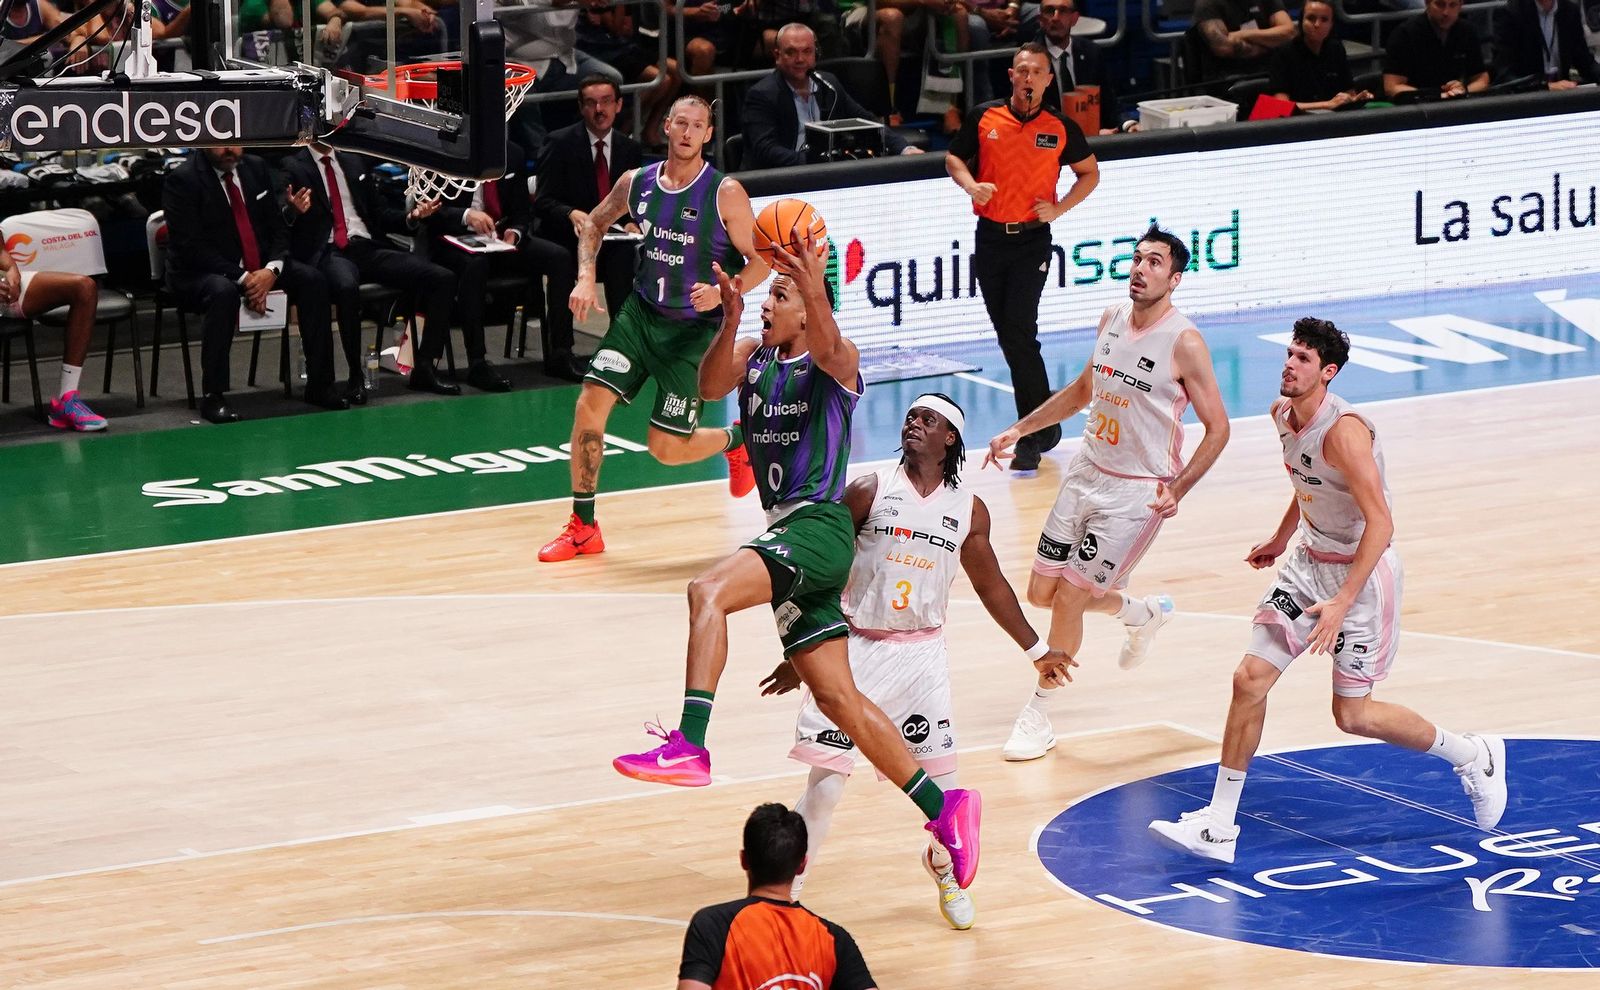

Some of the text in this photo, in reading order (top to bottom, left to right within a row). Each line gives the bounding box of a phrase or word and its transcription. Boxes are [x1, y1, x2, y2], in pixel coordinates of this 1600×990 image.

[10, 91, 241, 146] endesa
[1416, 172, 1596, 245] La salu
[41, 229, 98, 245] COSTA DEL SOL
[653, 226, 695, 246] Unicaja
[646, 247, 685, 266] málaga
[657, 277, 665, 302] 1
[763, 401, 809, 418] Unicaja
[752, 428, 800, 446] málaga
[1095, 412, 1119, 446] 29
[768, 462, 783, 492] 0
[886, 551, 936, 571] LLEIDA
[891, 580, 912, 611] 3
[903, 720, 929, 737] Q2
